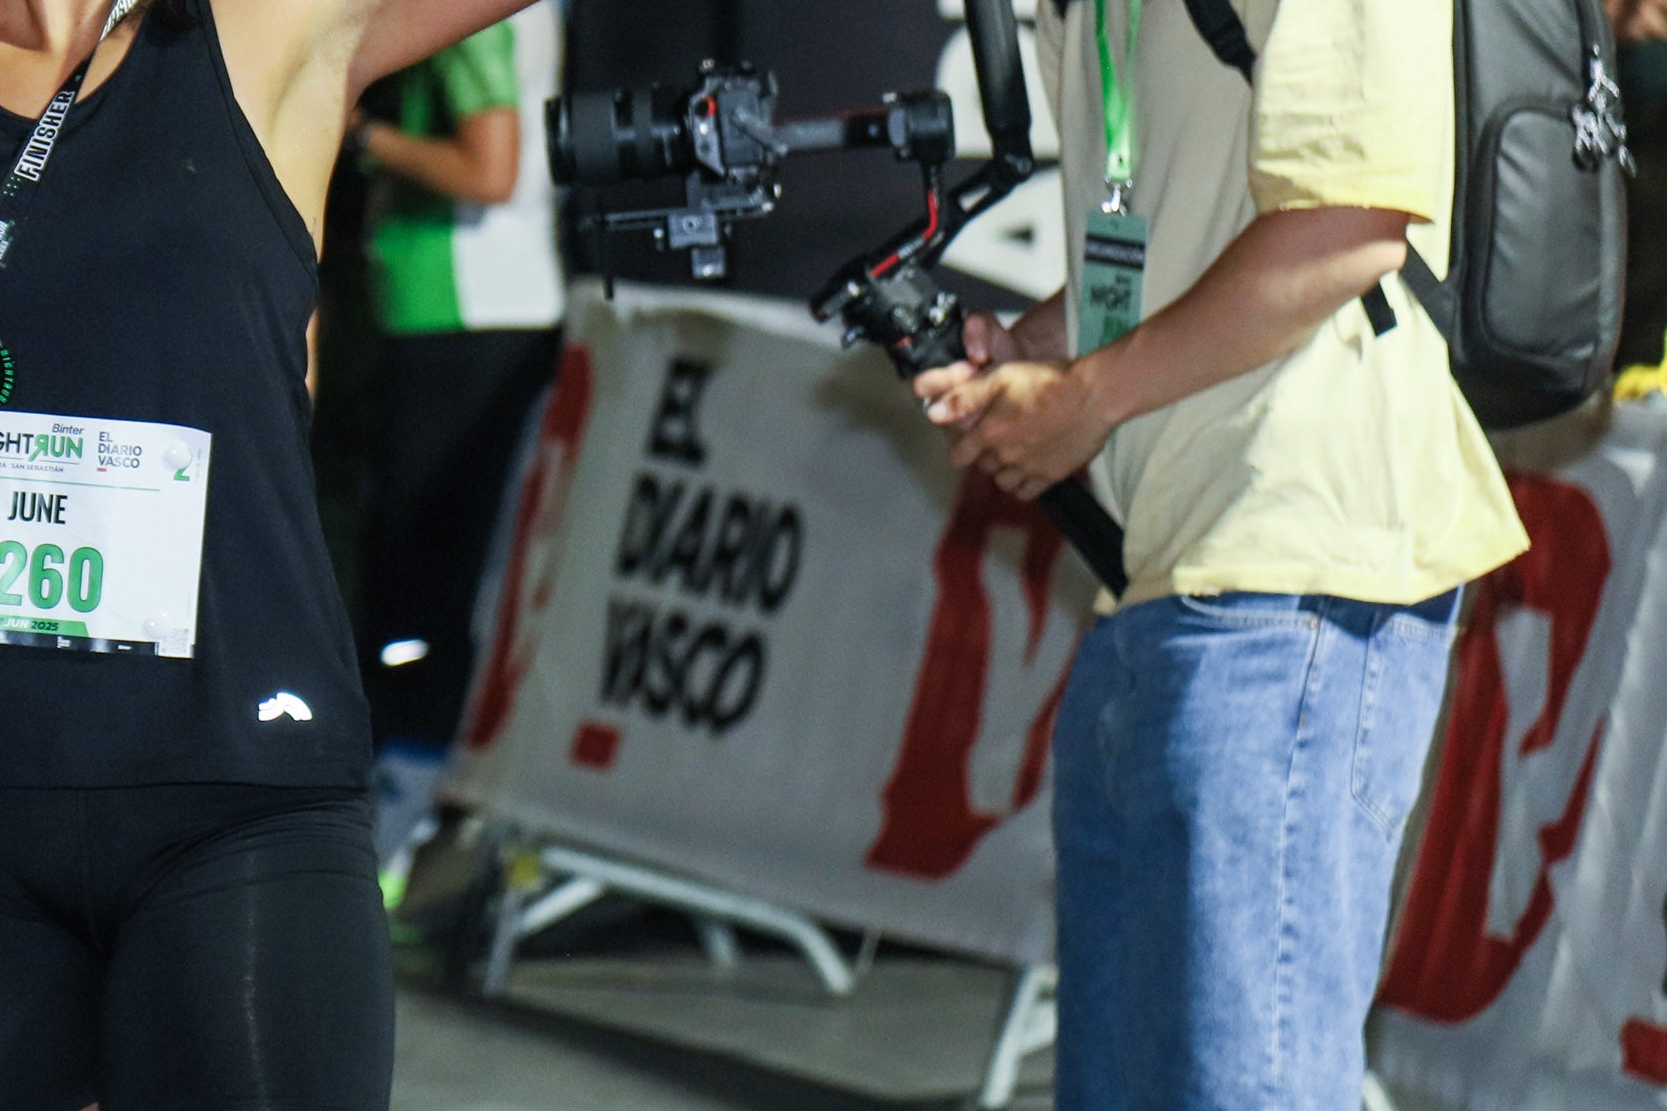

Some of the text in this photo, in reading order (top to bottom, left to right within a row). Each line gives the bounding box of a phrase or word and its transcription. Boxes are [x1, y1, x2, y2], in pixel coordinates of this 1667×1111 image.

[14, 90, 75, 182] FINISHER
[51, 423, 84, 436] Binter
[98, 430, 113, 443] EL
[97, 442, 143, 457] DIARIO
[10, 462, 26, 471] SAN
[97, 455, 141, 470] VASCO
[7, 492, 68, 525] JUNE
[614, 474, 807, 617] DIARIO
[4, 619, 30, 629] JUN
[31, 621, 59, 632] 2025
[598, 591, 767, 742] VASCO
